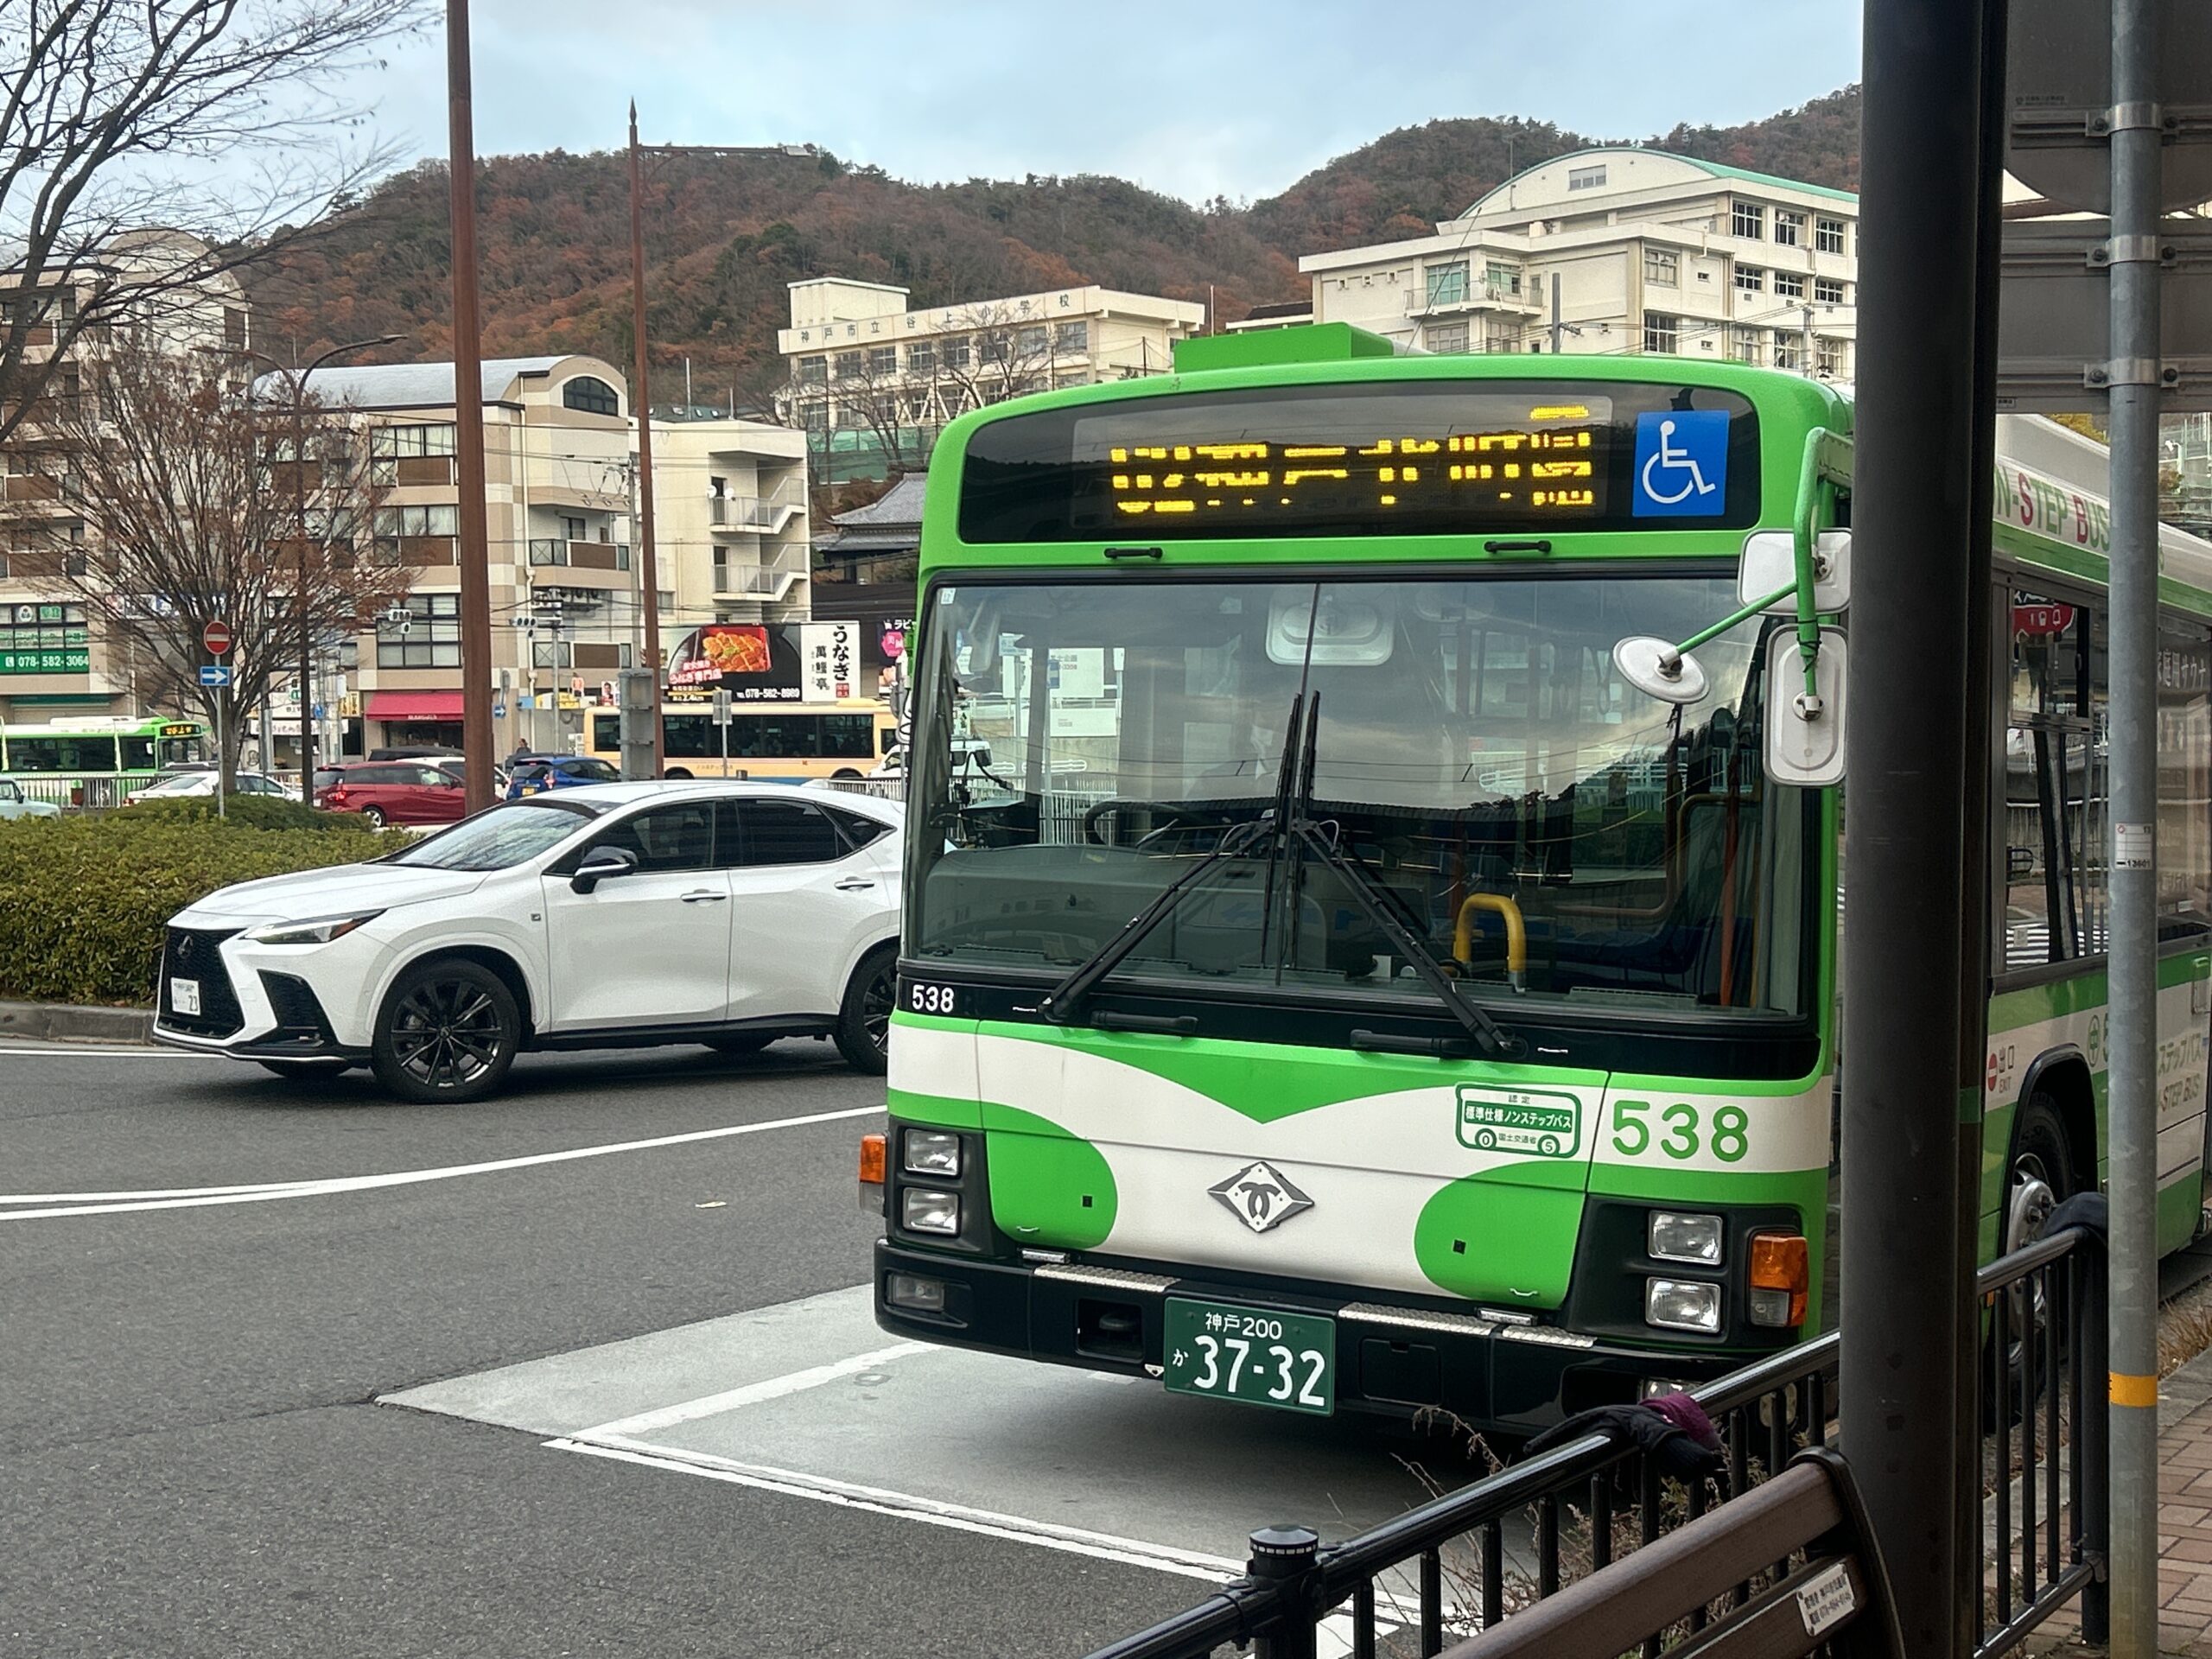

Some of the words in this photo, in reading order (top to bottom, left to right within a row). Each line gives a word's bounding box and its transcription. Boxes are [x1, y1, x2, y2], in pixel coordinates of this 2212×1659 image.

[2072, 494, 2110, 552] BUS
[832, 624, 850, 681] うなぎ
[912, 983, 955, 1014] 538
[1999, 1044, 2015, 1074] 出口
[1508, 1094, 1531, 1104] 認定
[1465, 1104, 1573, 1129] 標準仕様ノンステップバス
[1611, 1099, 1749, 1163] 538
[1498, 1132, 1537, 1145] 国土交通省
[1172, 1348, 1190, 1368] か
[1192, 1334, 1326, 1408] 37-32
